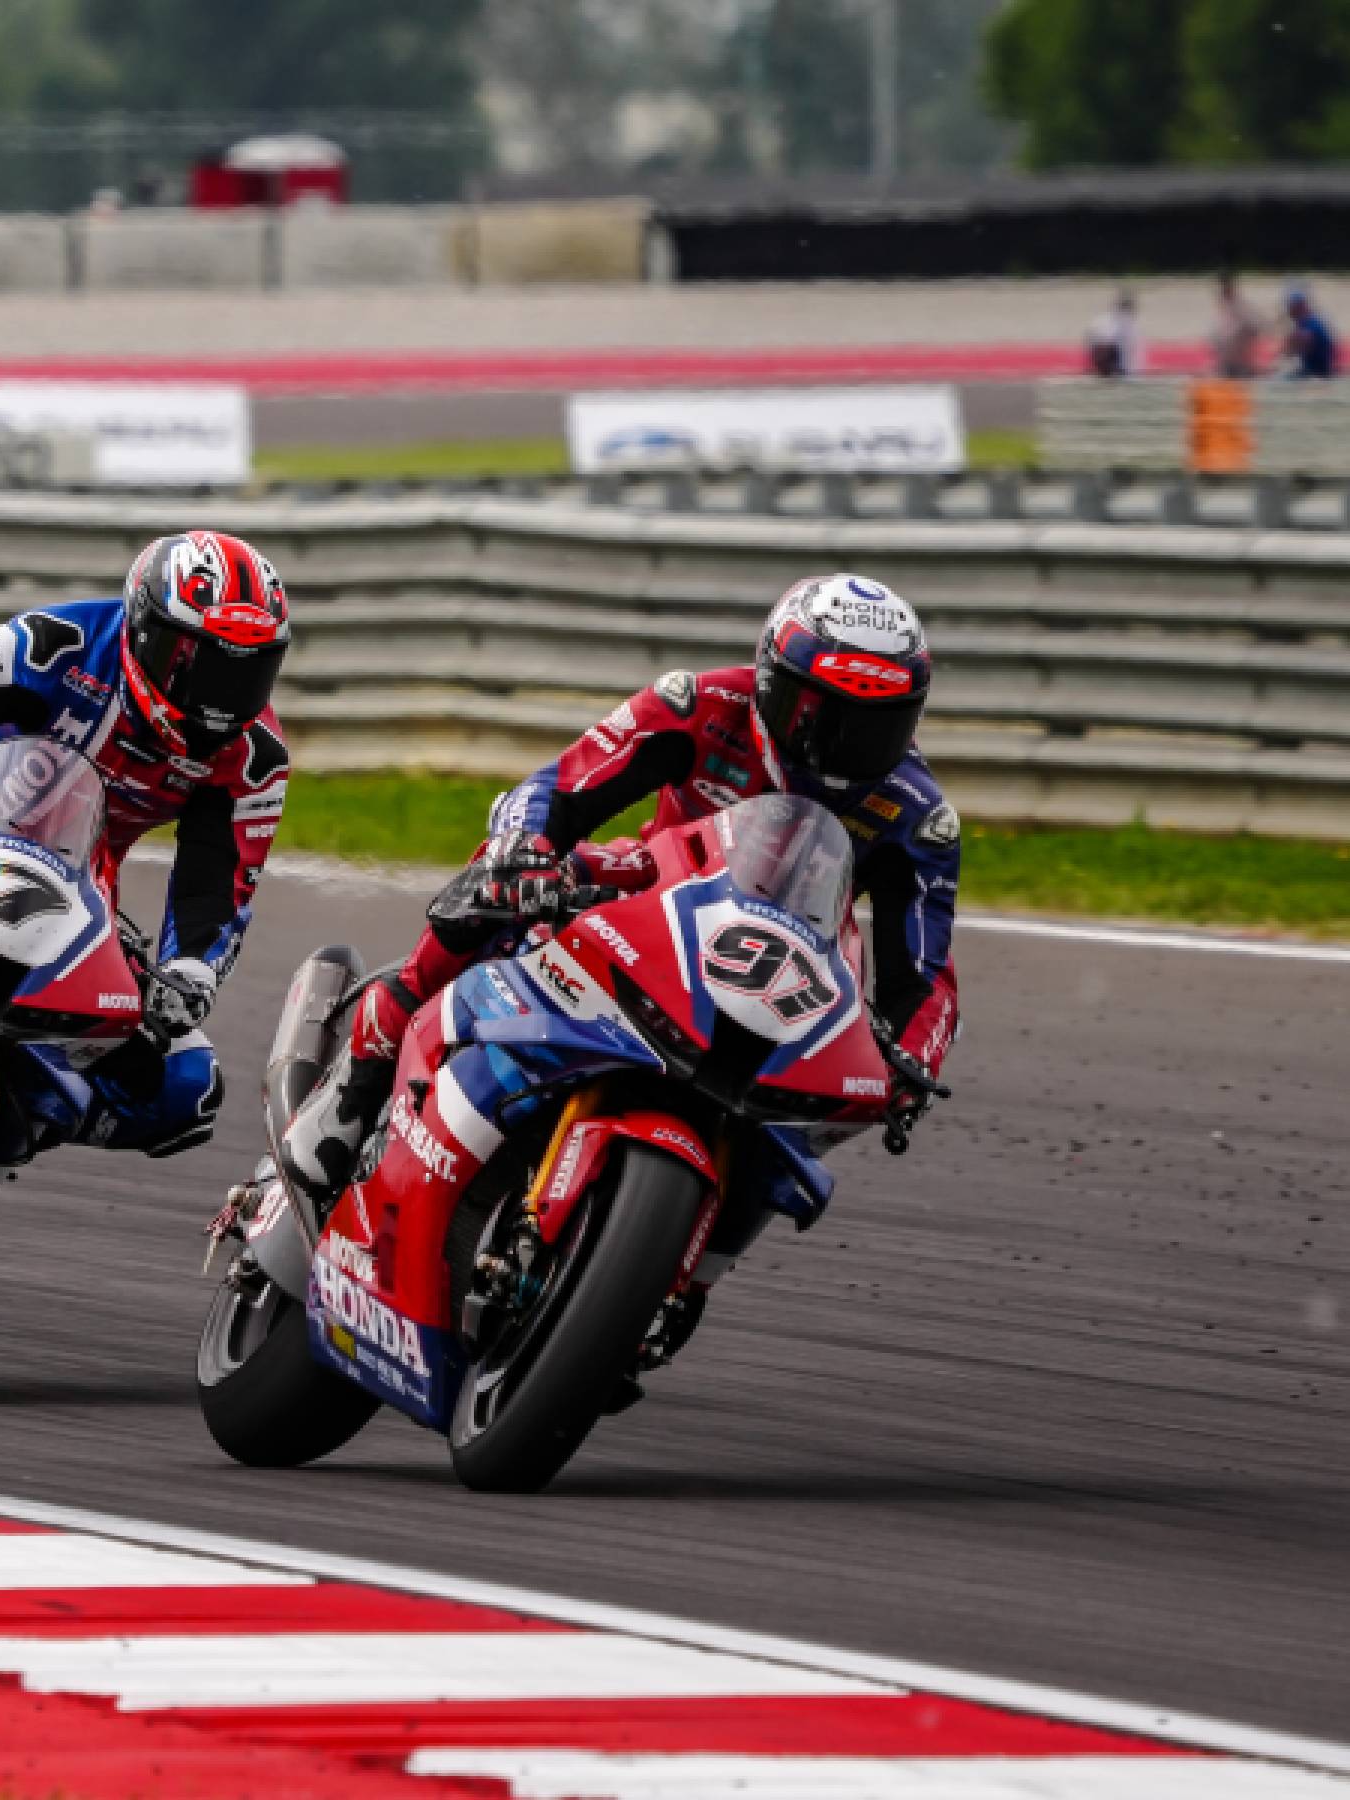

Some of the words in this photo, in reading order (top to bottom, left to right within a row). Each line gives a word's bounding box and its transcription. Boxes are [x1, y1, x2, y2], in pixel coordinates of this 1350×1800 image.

[842, 613, 898, 633] GRUP
[584, 915, 641, 967] MOTUL
[743, 902, 820, 949] HONDA
[537, 953, 587, 1002] HRC
[701, 920, 843, 1026] 97
[97, 992, 141, 1012] MOTUL
[842, 1076, 887, 1098] MOTUL
[316, 1254, 432, 1379] HONDA
